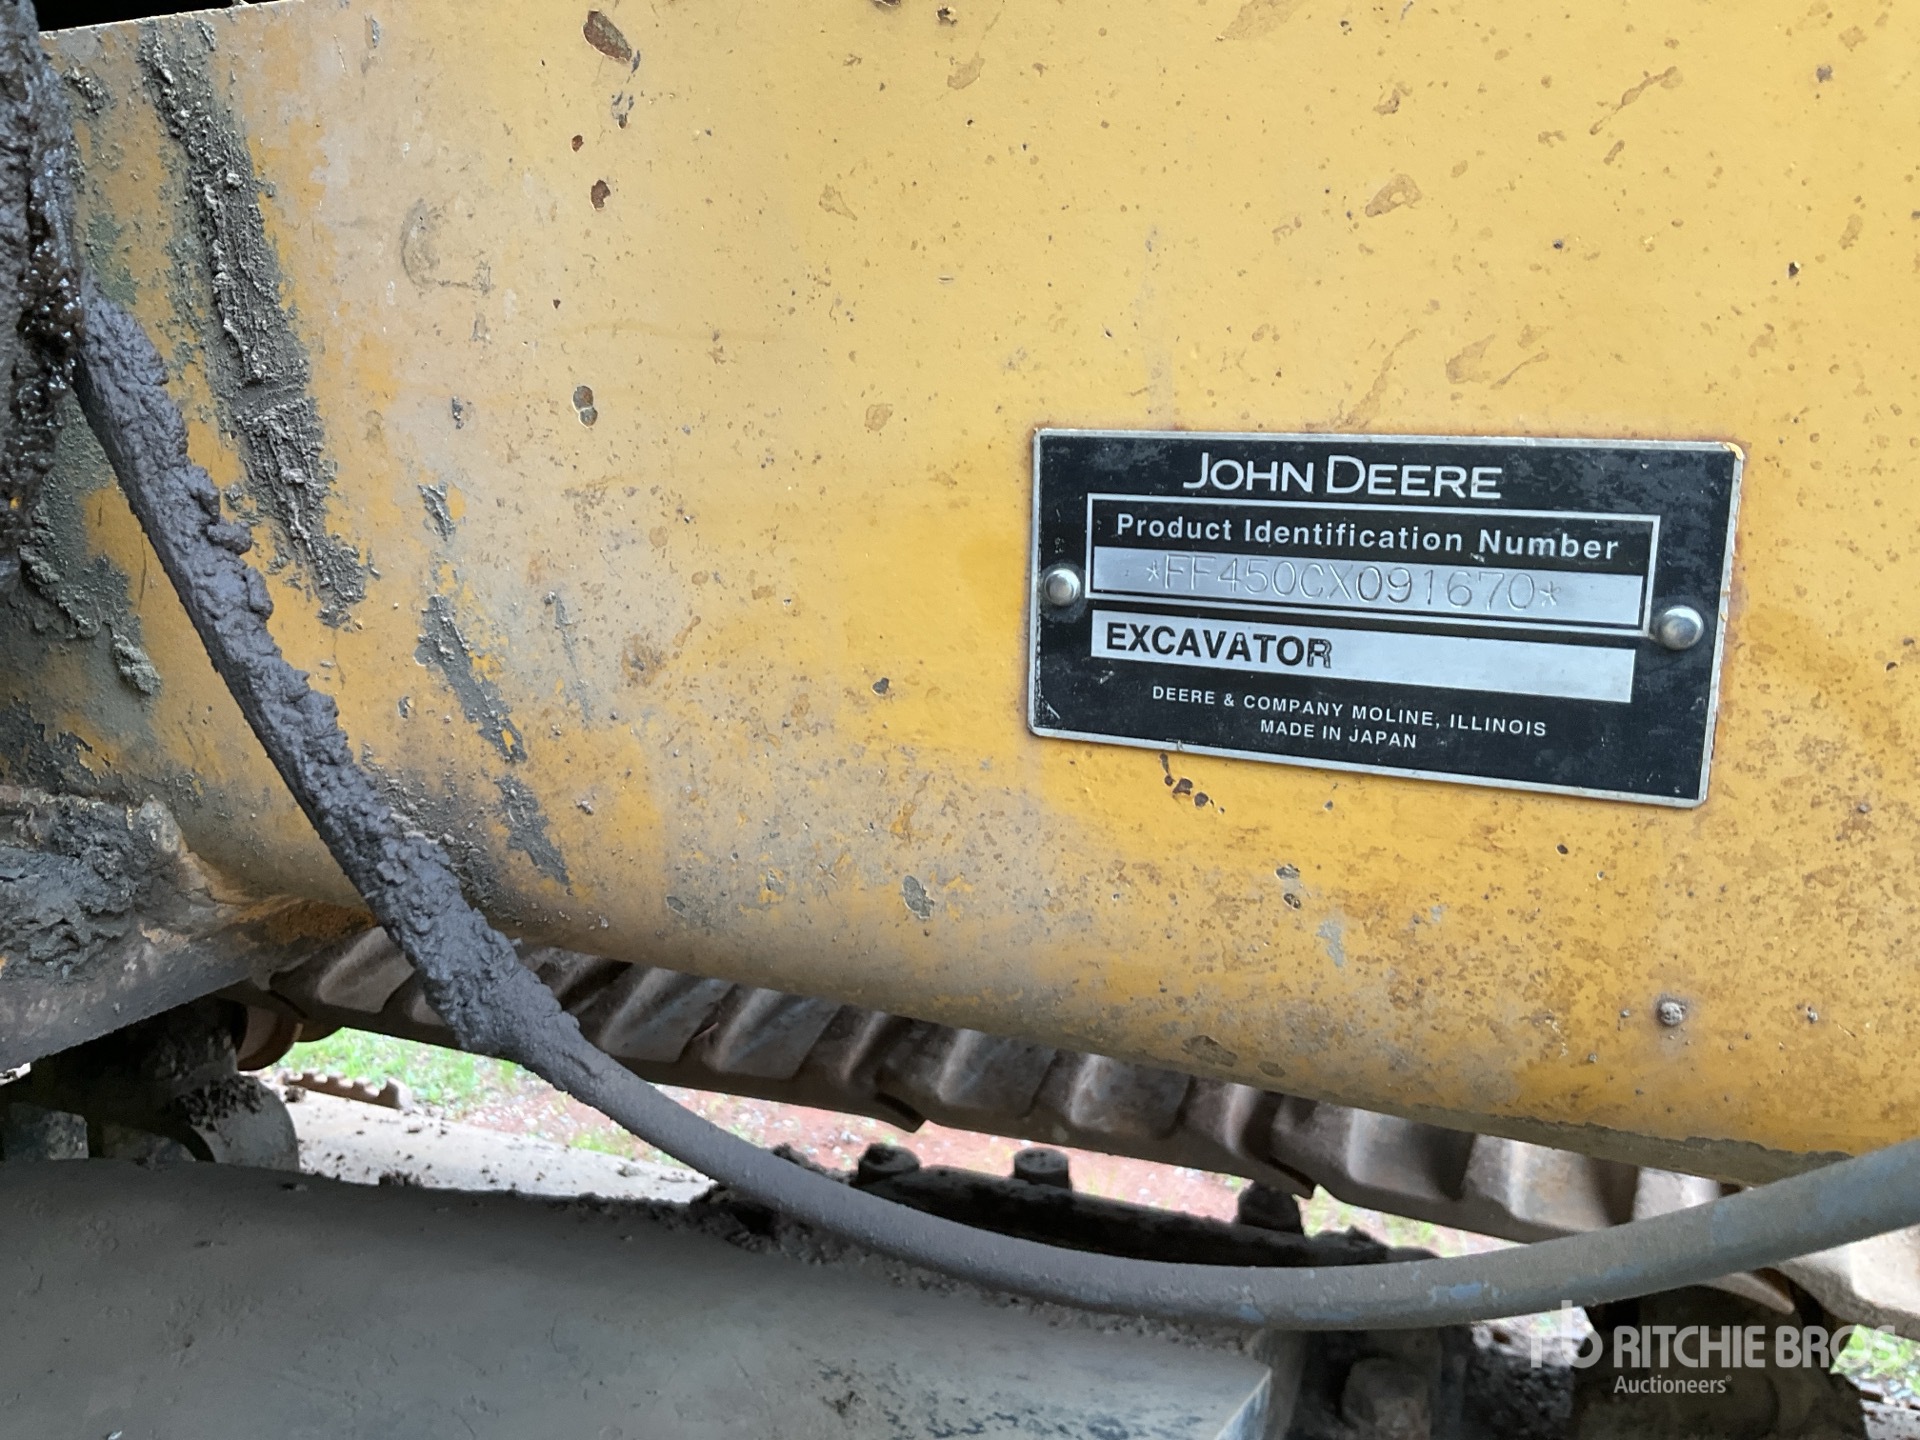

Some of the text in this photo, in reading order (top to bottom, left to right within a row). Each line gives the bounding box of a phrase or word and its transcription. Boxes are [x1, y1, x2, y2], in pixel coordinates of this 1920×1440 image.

[1183, 452, 1502, 499] JOHN DEERE
[1117, 513, 1619, 560] Product Identification Number
[1106, 623, 1331, 669] EXCAVATOR
[1152, 686, 1547, 737] DEERE & COMPANY MOLINE, ILLINOIS
[1260, 718, 1417, 749] MADE IN JAPAN
